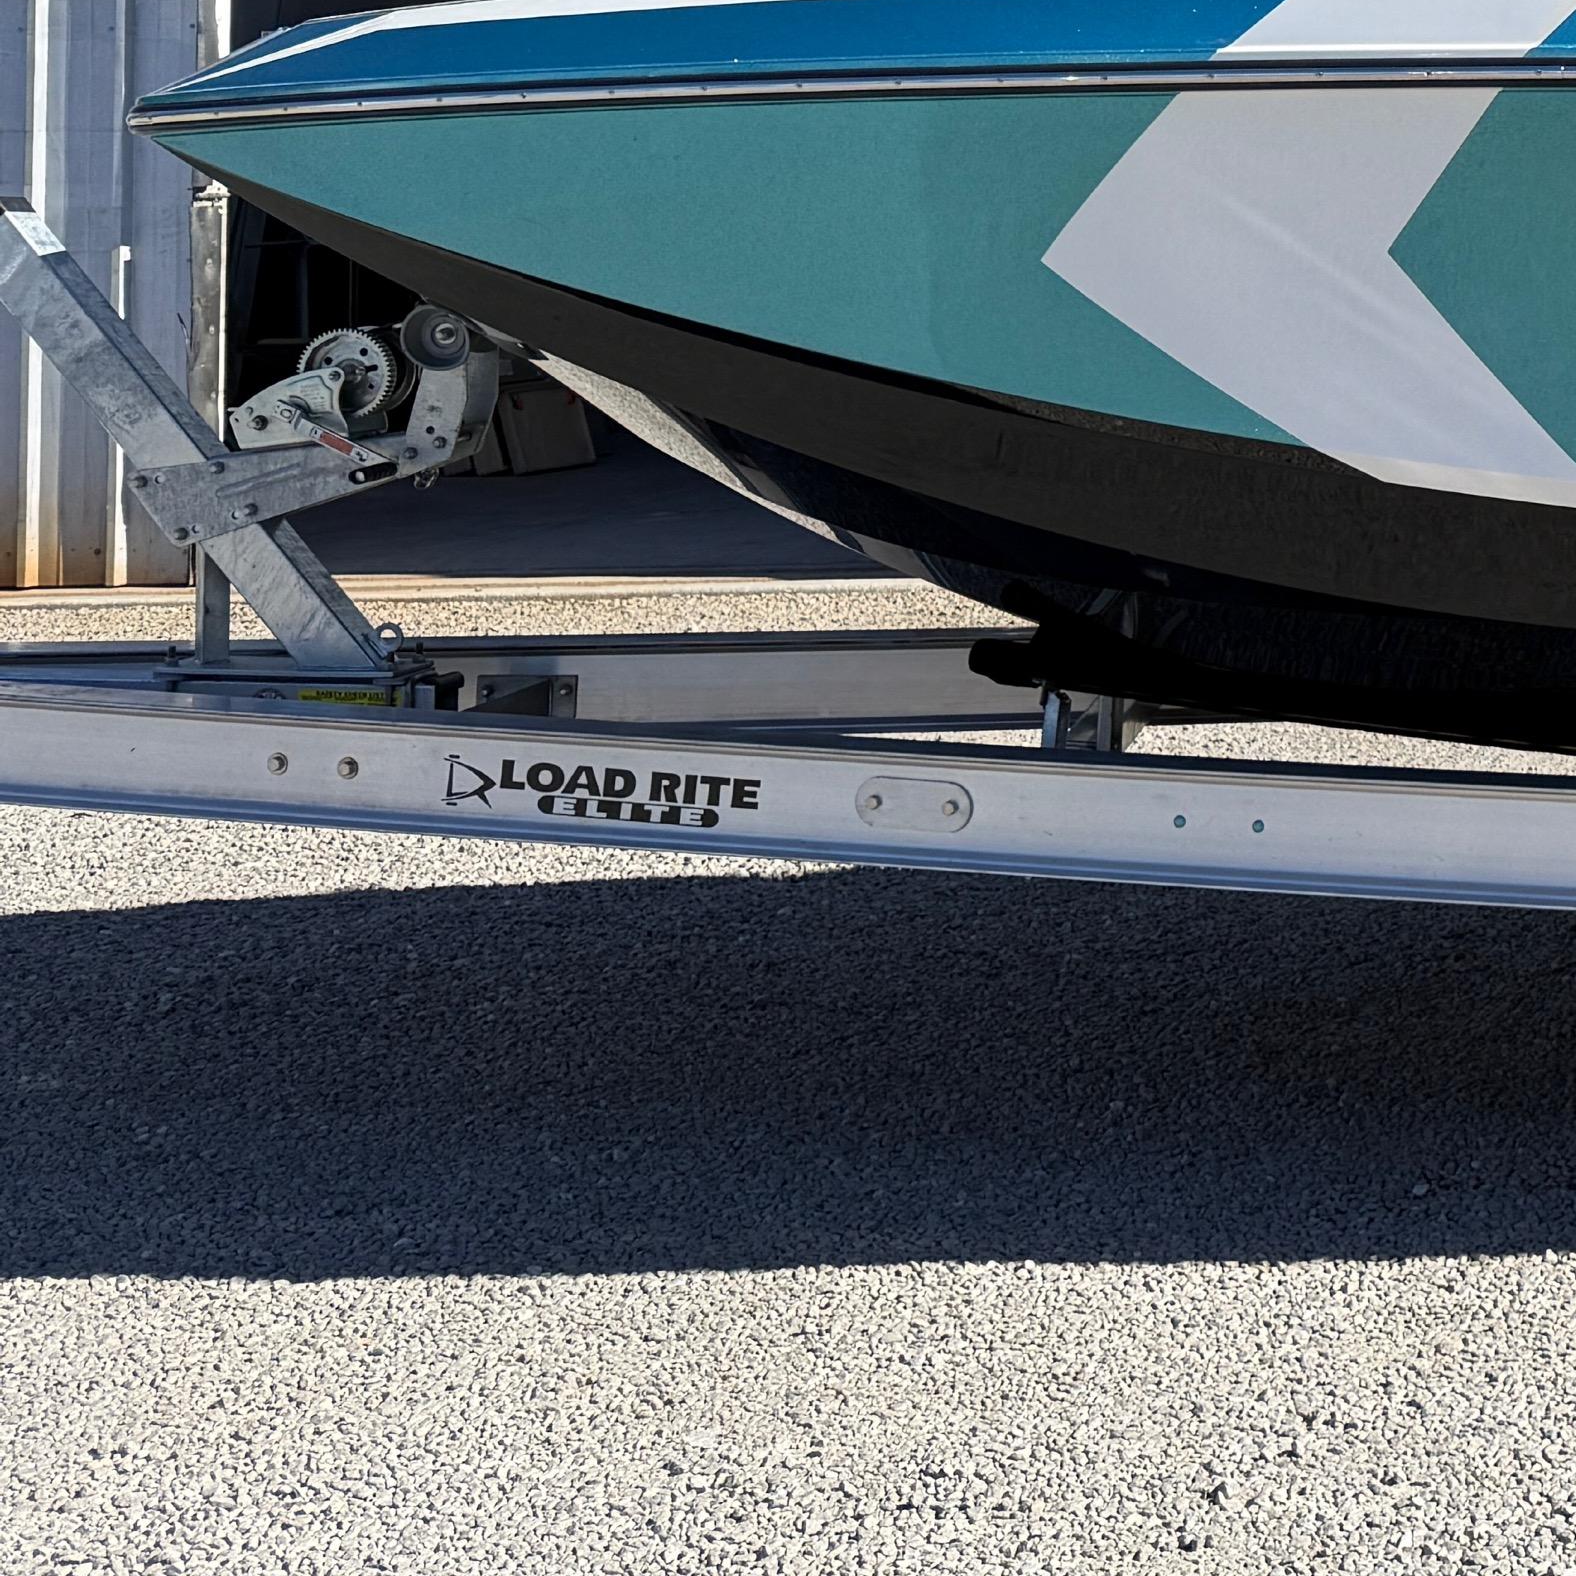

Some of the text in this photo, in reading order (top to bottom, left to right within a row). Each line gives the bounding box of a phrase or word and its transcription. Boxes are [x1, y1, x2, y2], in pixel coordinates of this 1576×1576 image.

[500, 759, 761, 810] LOAD RITE
[552, 797, 705, 826] ELITE
